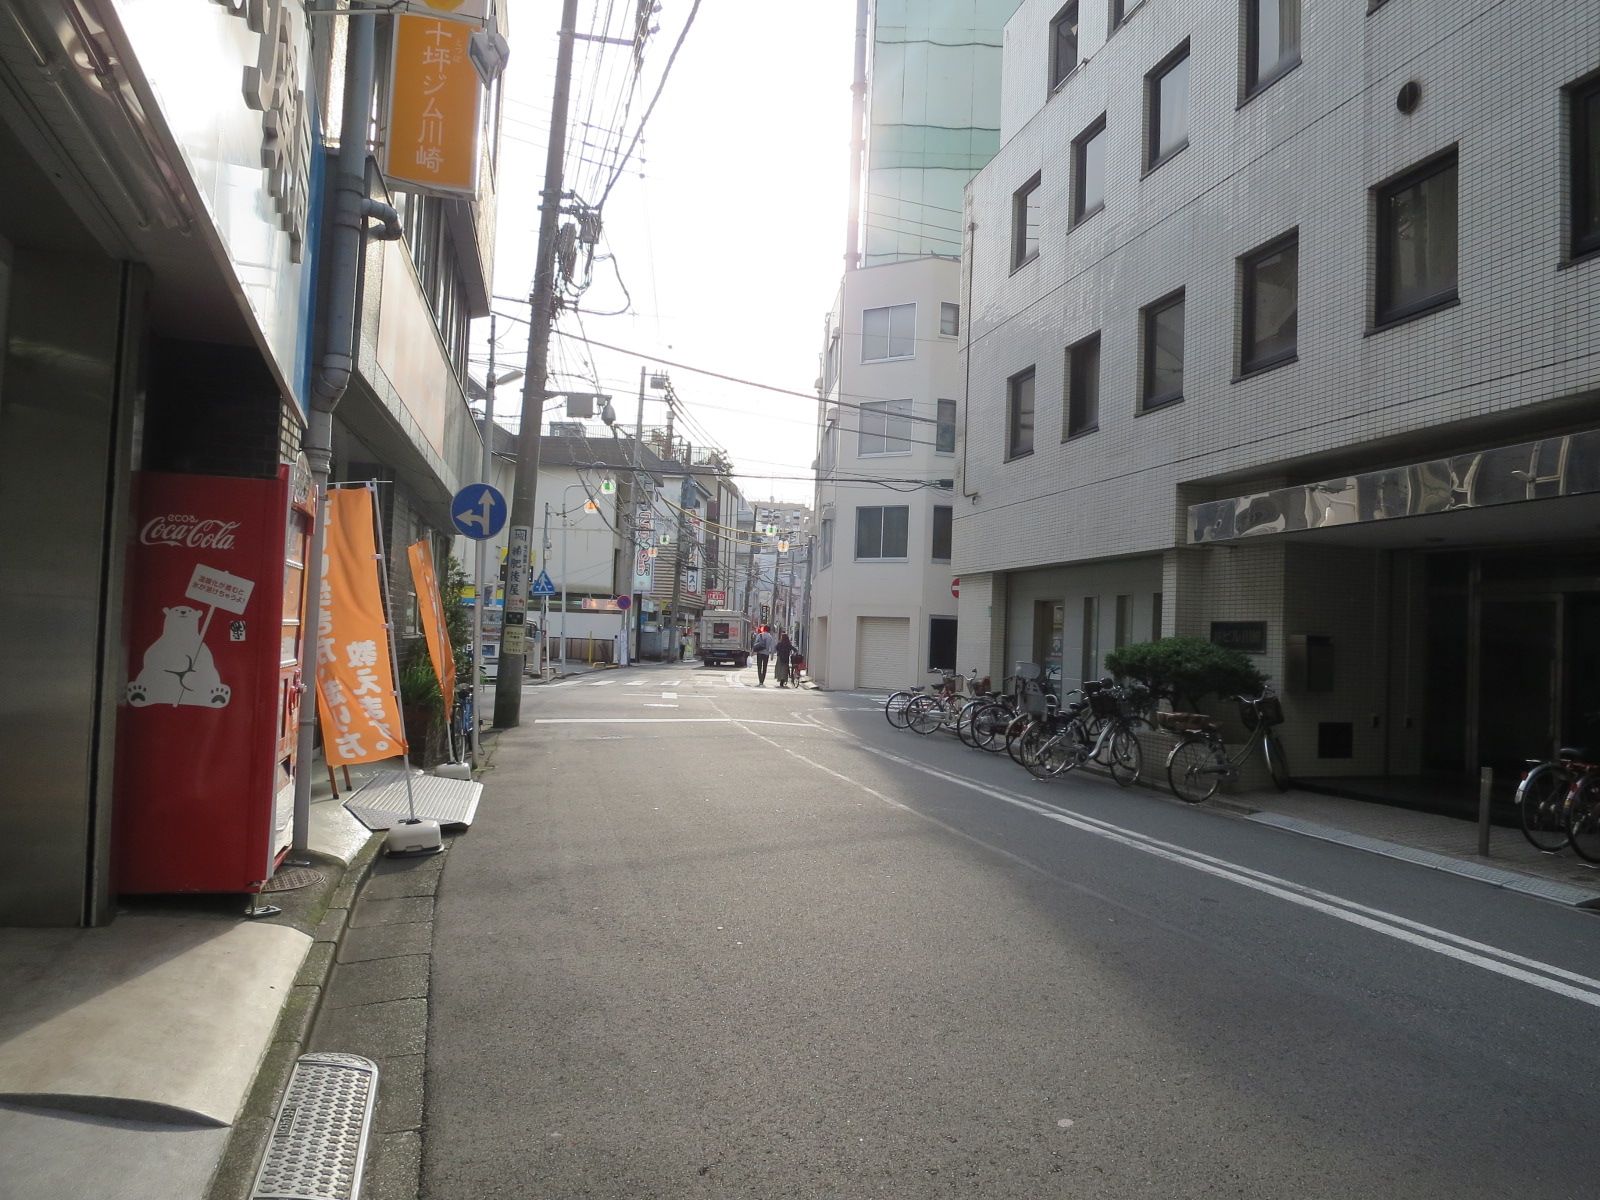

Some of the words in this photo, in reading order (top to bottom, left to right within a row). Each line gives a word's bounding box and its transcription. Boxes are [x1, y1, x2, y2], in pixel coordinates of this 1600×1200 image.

[416, 22, 452, 173] 十坪ジム川崎
[139, 516, 241, 550] Coca-Cola
